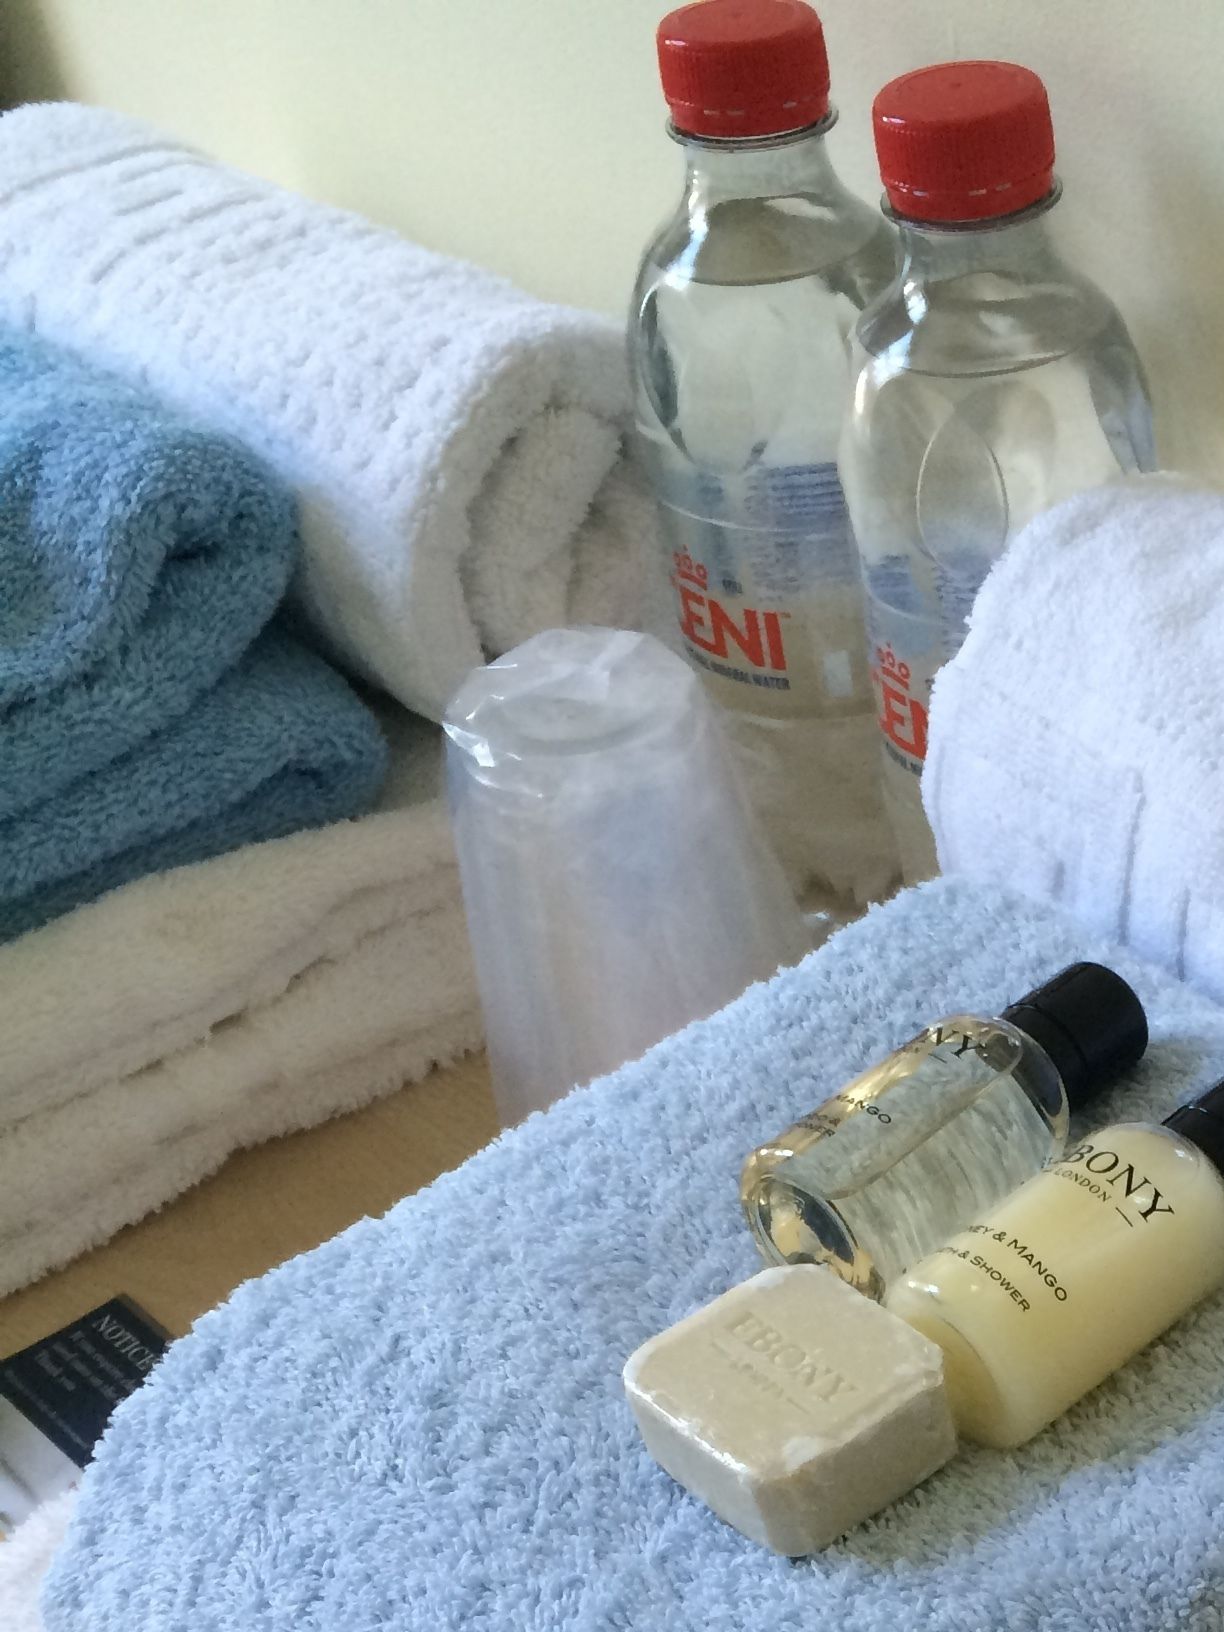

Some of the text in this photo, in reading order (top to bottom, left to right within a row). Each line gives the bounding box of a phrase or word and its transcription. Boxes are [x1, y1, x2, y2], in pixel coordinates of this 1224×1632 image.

[1061, 1143, 1175, 1223] BONY
[969, 1254, 1031, 1313] SHOWER
[992, 1231, 1007, 1243] &
[1006, 1238, 1068, 1302] MANGO
